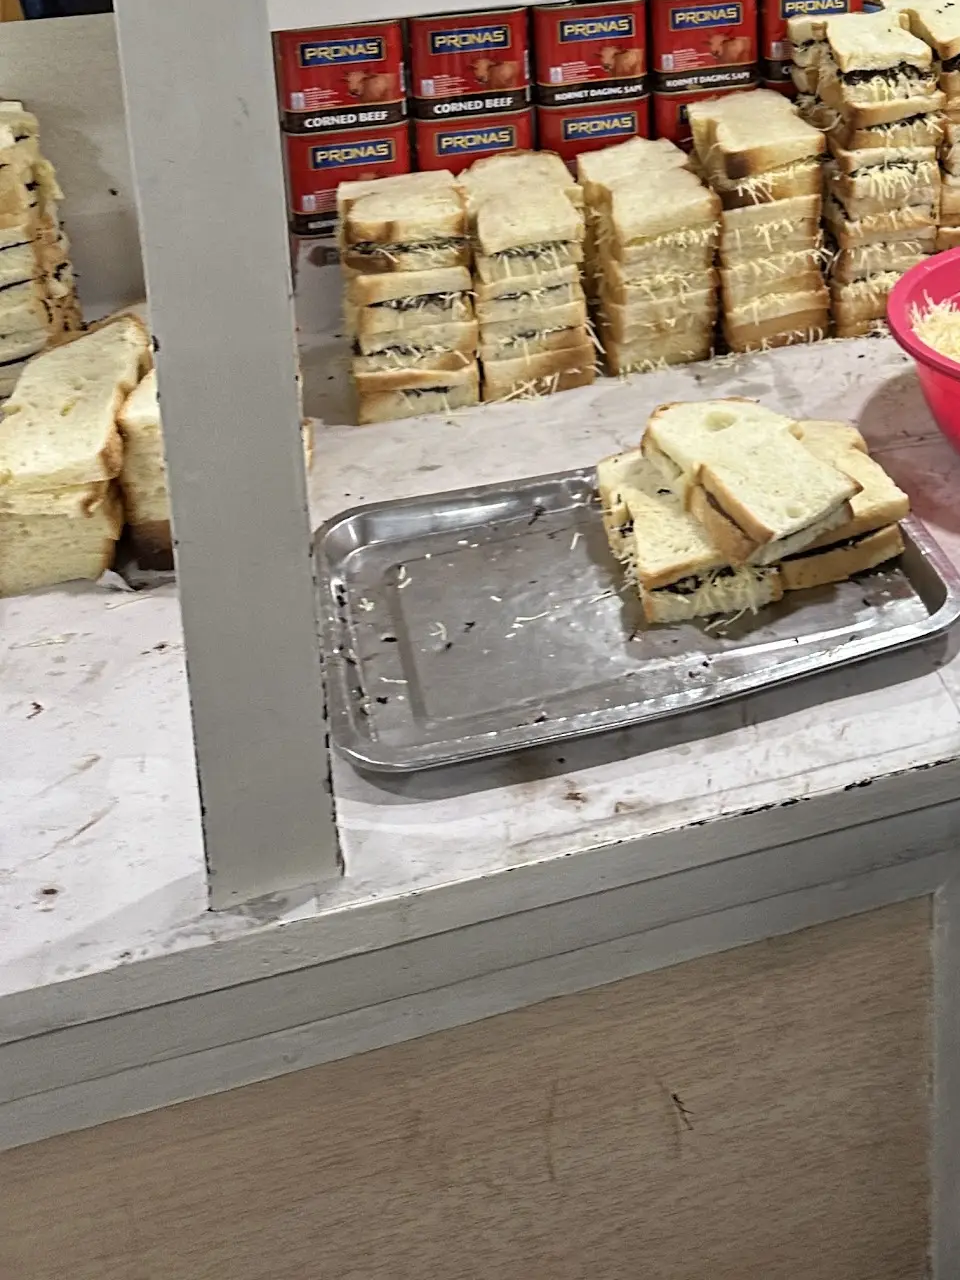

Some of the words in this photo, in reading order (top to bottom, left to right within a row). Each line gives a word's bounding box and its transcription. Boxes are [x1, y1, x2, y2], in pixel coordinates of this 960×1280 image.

[675, 7, 738, 26] PRONAS
[564, 19, 630, 39] PRONAS
[434, 30, 505, 49] PRONAS
[304, 41, 380, 61] PRONAS
[433, 100, 483, 114] CORNED
[484, 97, 514, 109] BEEF
[304, 113, 357, 129] CORNED
[359, 110, 389, 123] BEEF
[567, 116, 632, 134] PRONAS
[441, 130, 511, 150] PRONAS
[315, 143, 389, 163] PRONAS
